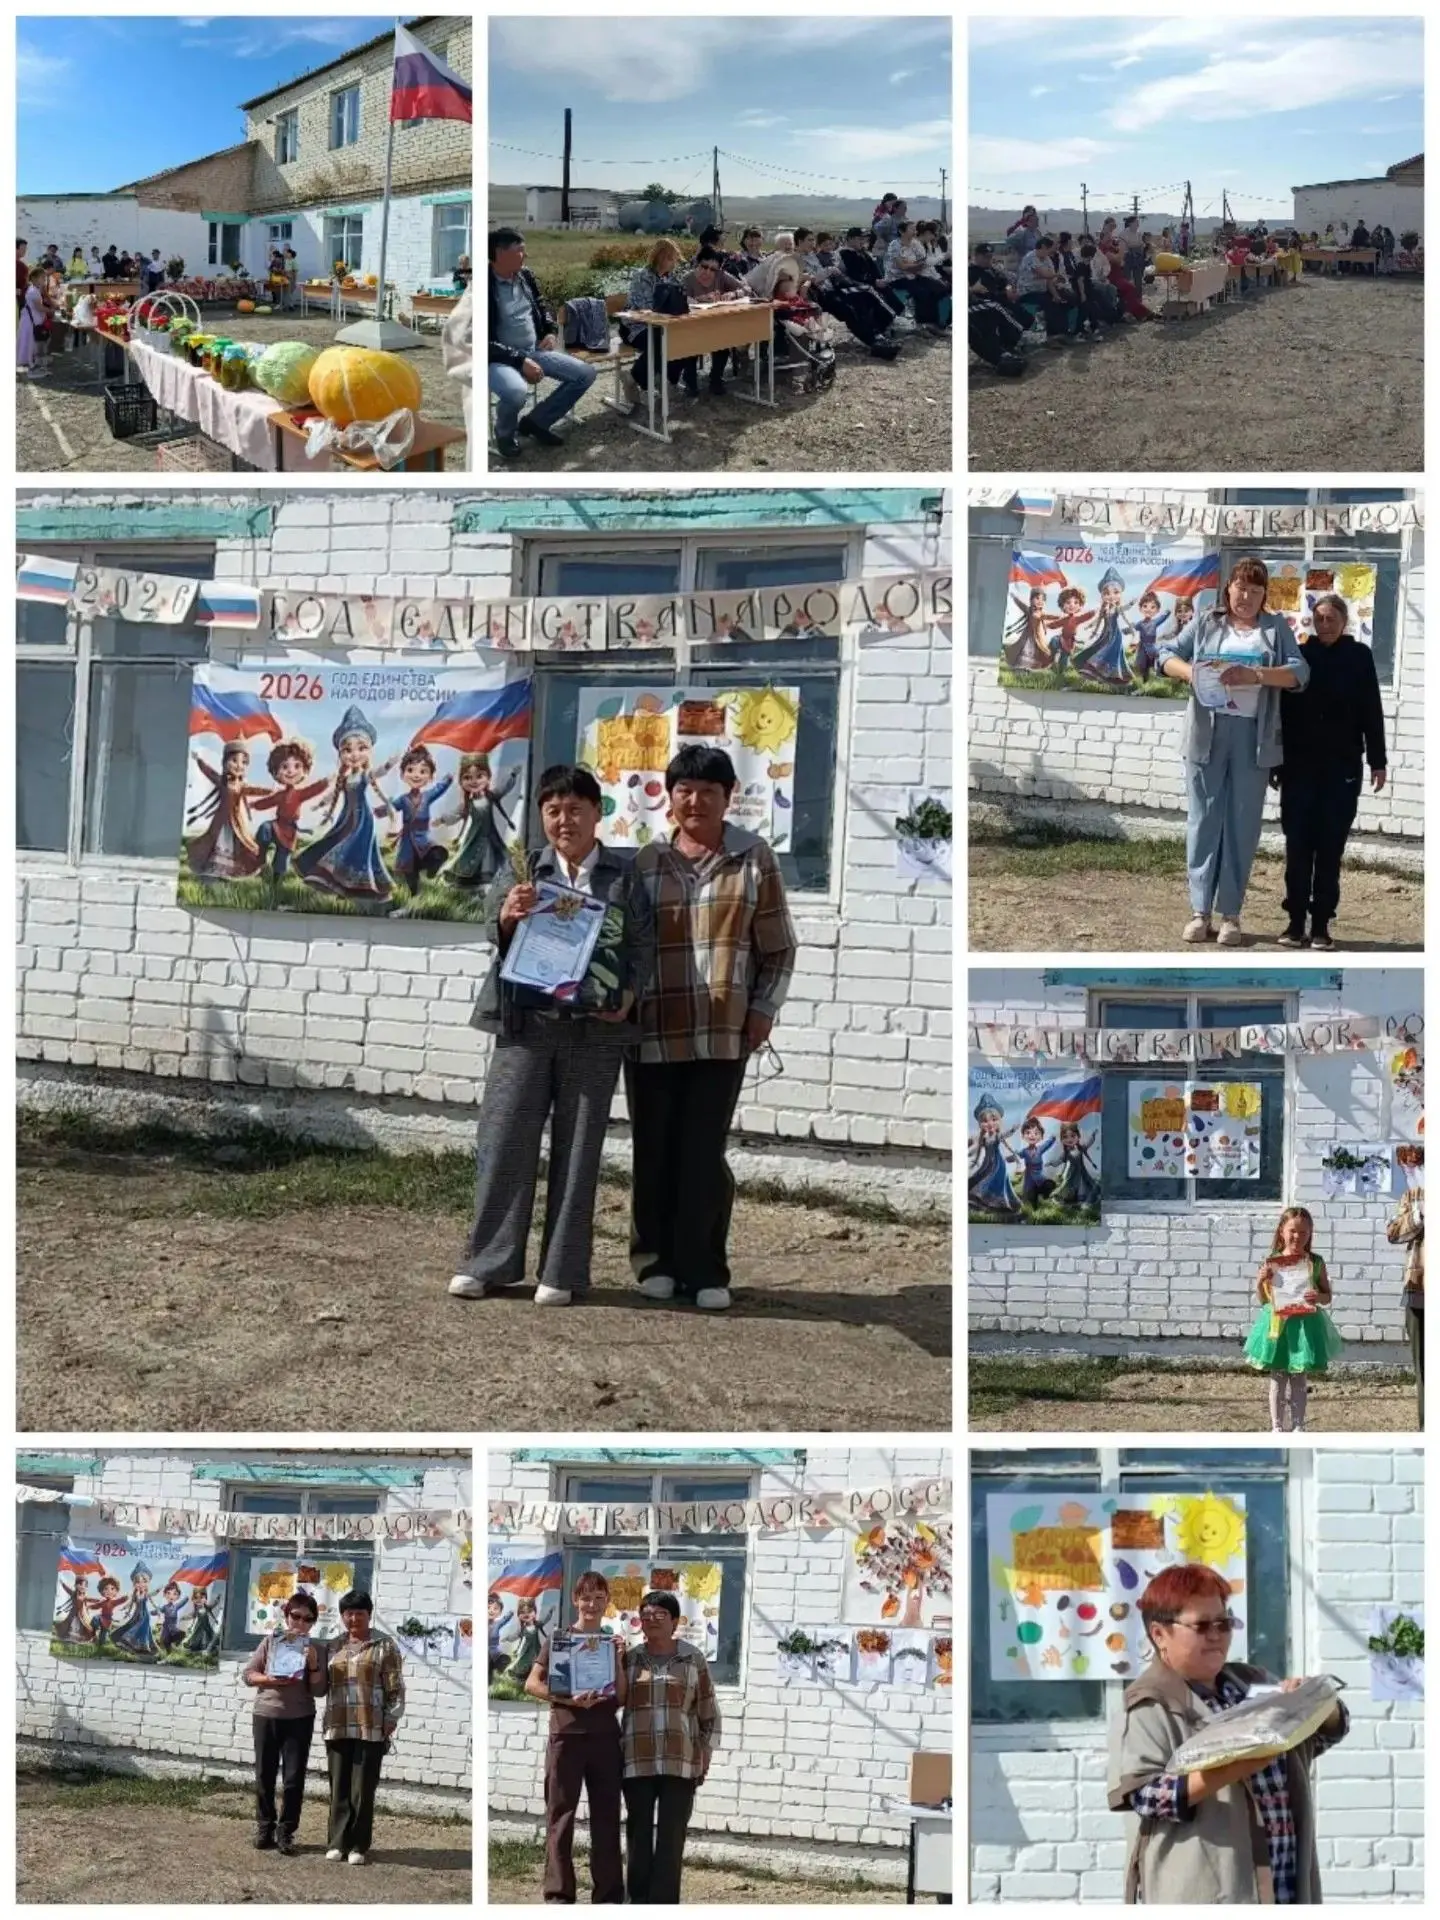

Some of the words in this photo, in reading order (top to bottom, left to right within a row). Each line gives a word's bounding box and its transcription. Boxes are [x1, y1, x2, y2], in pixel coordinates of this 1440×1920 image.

[1060, 499, 1111, 525] ГОД
[1055, 547, 1094, 563] 2026
[80, 571, 190, 616] 2026
[270, 590, 354, 639] ГОД
[260, 673, 324, 700] 2026
[331, 672, 359, 687] ГОД
[362, 673, 436, 687] ЕДИНСТВА
[330, 687, 396, 701] НАРОДОВ
[400, 688, 457, 701] РОССИИ
[851, 1481, 953, 1514] РОСС
